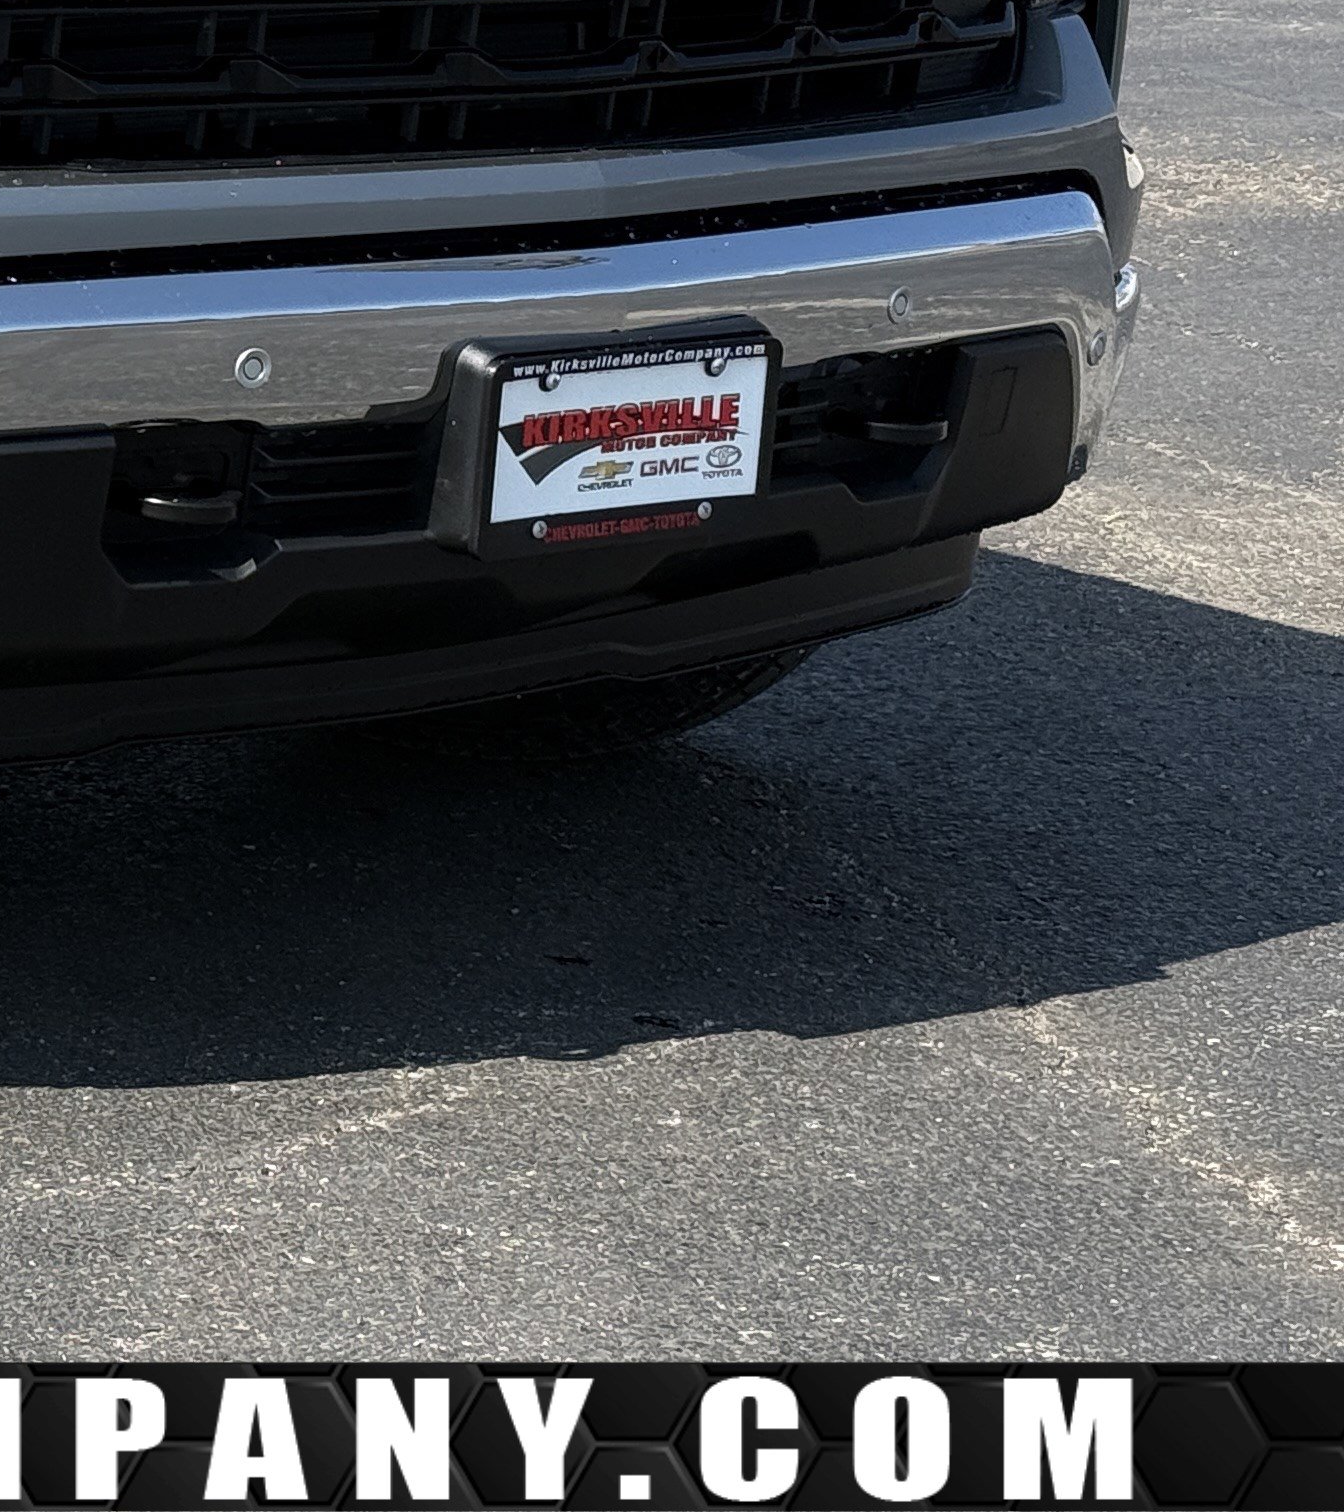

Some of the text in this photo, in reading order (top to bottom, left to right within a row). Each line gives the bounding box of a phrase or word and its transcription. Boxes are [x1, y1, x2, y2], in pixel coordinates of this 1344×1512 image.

[513, 344, 766, 378] www.KirksvilleMotorCompany.com
[522, 393, 740, 447] KIRKSVILLE
[601, 428, 738, 454] MOTOR COMPANY
[640, 455, 700, 478] GMC
[701, 468, 744, 479] TOYOTA
[577, 478, 634, 493] CHEVROLET
